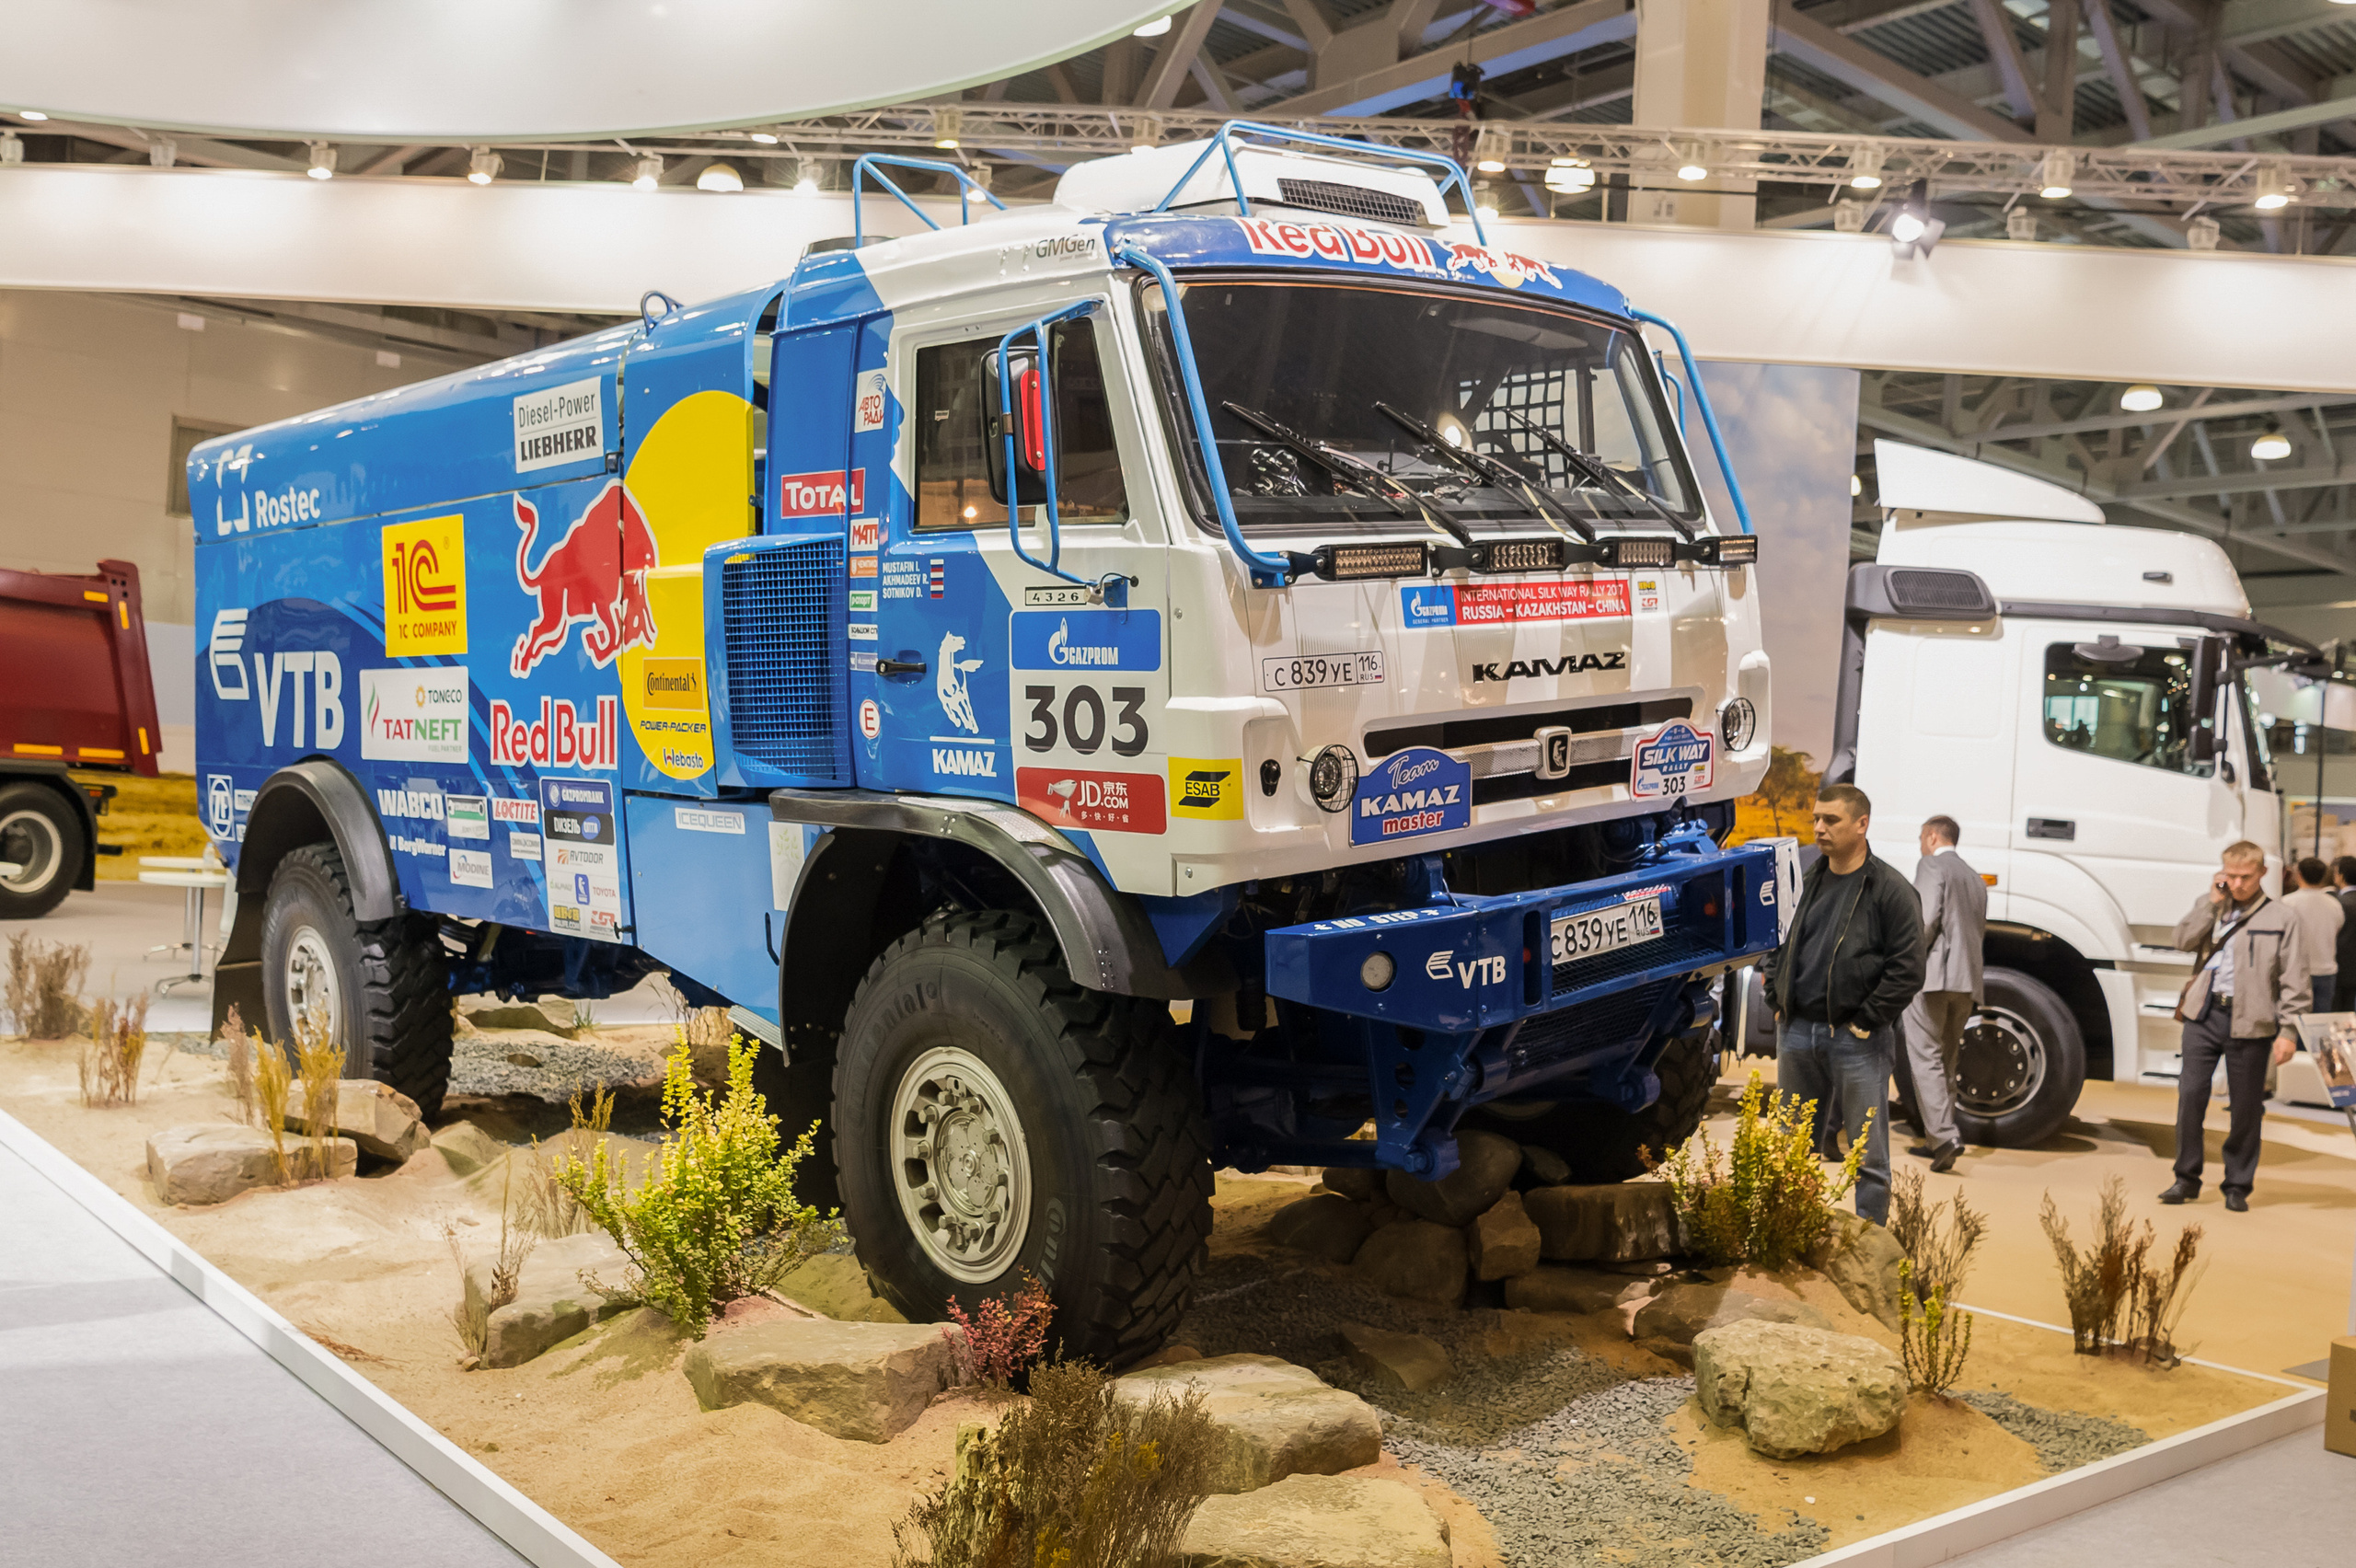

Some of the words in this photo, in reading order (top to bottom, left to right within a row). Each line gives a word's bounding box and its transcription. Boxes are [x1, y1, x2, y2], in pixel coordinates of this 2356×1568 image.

[1036, 234, 1095, 259] GMGen
[1240, 219, 1344, 256] Red
[1341, 227, 1432, 266] Bull
[518, 391, 596, 429] Diesel-Power
[858, 394, 881, 413] АВТО
[520, 425, 597, 462] LIEBHERR
[785, 481, 861, 511] TOTAL
[255, 487, 321, 528] Rostec
[882, 561, 914, 574] MUSTAFIN
[915, 560, 920, 572] I.
[882, 573, 921, 587] AKHMADEEV
[922, 573, 929, 585] R.
[882, 587, 915, 599] SOTNIKOV
[916, 586, 923, 598] D.
[1461, 587, 1537, 602] INTERNATIONAL
[1538, 586, 1557, 599] SILK
[1558, 585, 1577, 598] WAY
[1461, 605, 1505, 620] RUSSIA
[1515, 601, 1587, 617] KAZAKHSTAN
[1596, 598, 1626, 614] CHINA
[412, 620, 457, 638] COMPANY
[1068, 646, 1119, 665] GAZPROM
[1358, 654, 1378, 672] 116
[1360, 672, 1374, 681] RUS
[1472, 651, 1626, 684] KAMAZ
[647, 673, 690, 696] Continental
[253, 651, 345, 750] VTB
[383, 719, 462, 741] TATNEFT
[640, 720, 707, 734] POWER-PACKER
[864, 708, 876, 731] E
[1024, 685, 1149, 757] 303
[492, 698, 550, 763] Red
[555, 698, 616, 766] Bull
[663, 748, 704, 769] Webasto
[932, 748, 998, 778] KAMAZ
[1642, 746, 1678, 767] SILK
[1679, 742, 1708, 762] WAY
[1388, 755, 1439, 790] Team
[1662, 762, 1689, 773] RALLY
[561, 788, 605, 804] GAZPROMBANK
[1103, 781, 1128, 797] 京东
[1185, 782, 1220, 797] ESAB
[1662, 776, 1686, 796] 303
[377, 789, 445, 821] WABCO
[495, 801, 537, 820] LOCTITE
[1361, 785, 1461, 818] KAMAZ
[678, 812, 742, 830] ICEQUEEN
[1383, 811, 1444, 836] master
[398, 835, 446, 857] BorgWarner
[570, 850, 604, 865] AVTODOR
[457, 861, 490, 876] MODINE
[593, 886, 617, 898] TOYOTA
[1332, 918, 1366, 929] NO
[1369, 911, 1418, 924] STEP
[1629, 902, 1656, 930] 116
[1636, 927, 1650, 938] RUS
[1458, 955, 1507, 989] VTB
